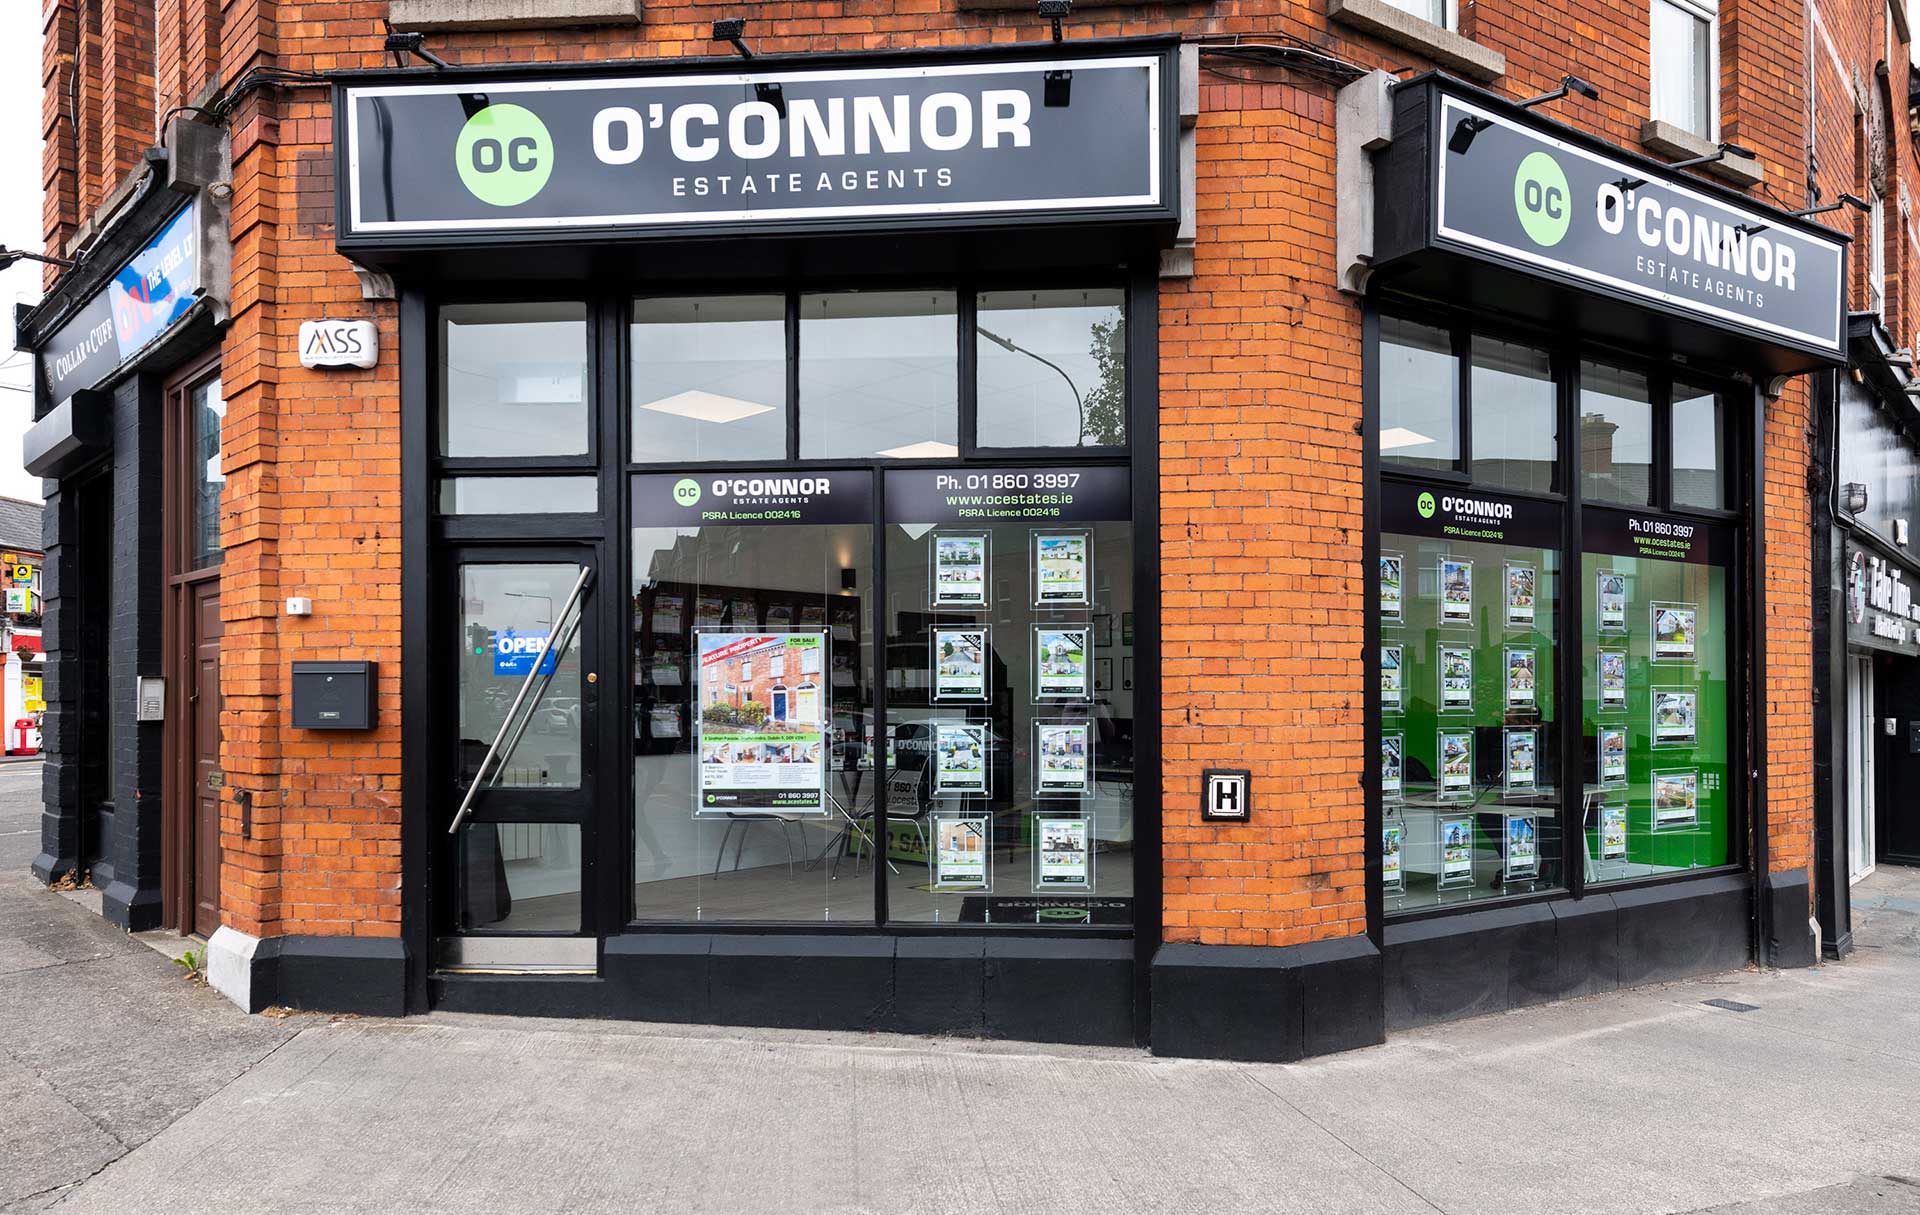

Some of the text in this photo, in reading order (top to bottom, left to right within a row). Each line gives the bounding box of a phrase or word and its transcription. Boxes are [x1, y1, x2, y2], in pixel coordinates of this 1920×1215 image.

[592, 89, 1031, 165] O'CONNOR
[472, 137, 538, 173] OC
[673, 168, 951, 196] ESTATE AGENTS
[1524, 179, 1562, 220] OC
[1597, 183, 1796, 291] O'CONNOR
[1637, 255, 1764, 308] ESTATE AGENTS
[712, 478, 830, 496] O'CONNOR
[936, 473, 1080, 490] Ph. 01 860 3997
[678, 488, 696, 497] OC
[946, 492, 1073, 505] www.ocestates.ie
[958, 508, 1060, 517] PSRA Licence 002416
[1420, 500, 1432, 510] OC
[1442, 496, 1512, 519] O'CONNOR
[702, 510, 801, 519] PSRA Licence 002416
[1455, 514, 1500, 525] ESTATE AGENTS
[1443, 526, 1460, 535] PSRA
[1460, 527, 1481, 537] Licence
[1629, 518, 1694, 538] Ph. 01 860 3997
[1633, 536, 1691, 550] www.ocestates.ie
[499, 637, 550, 654] OPEN
[1216, 782, 1237, 809] H
